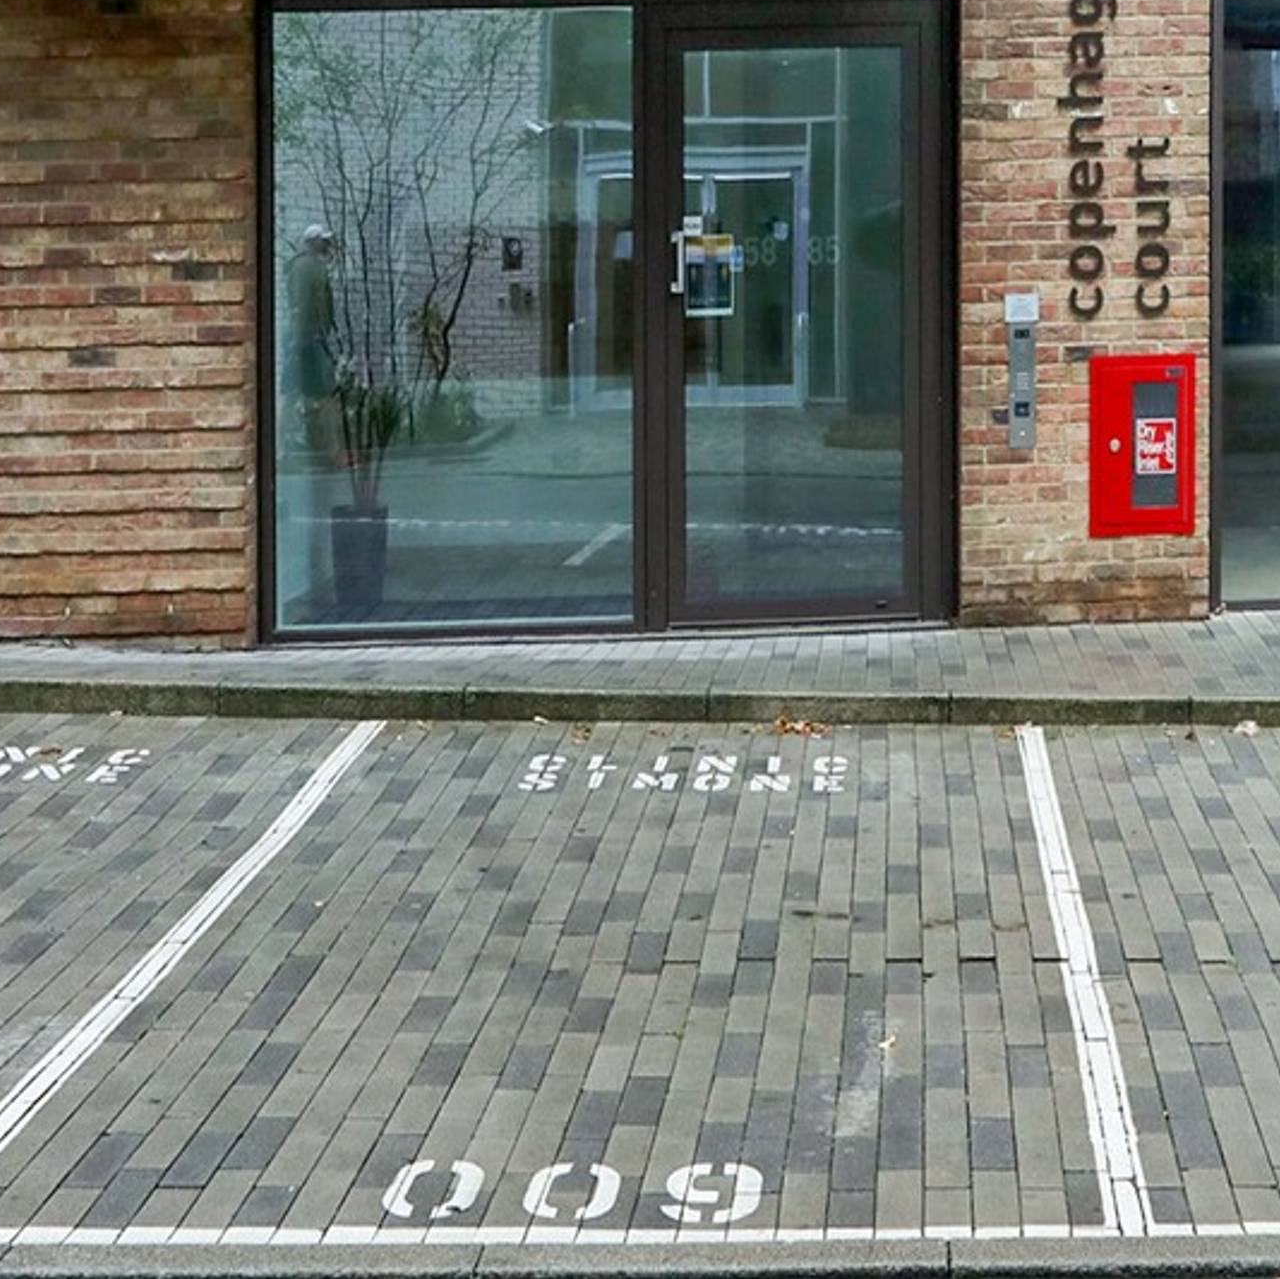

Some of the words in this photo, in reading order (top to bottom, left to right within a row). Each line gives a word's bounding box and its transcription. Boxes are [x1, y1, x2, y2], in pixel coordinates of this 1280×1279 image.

[1126, 137, 1170, 318] court
[743, 235, 776, 266] 58
[528, 754, 849, 772] CLINIC
[518, 772, 845, 792] SIMONE
[382, 1159, 764, 1223] 009
